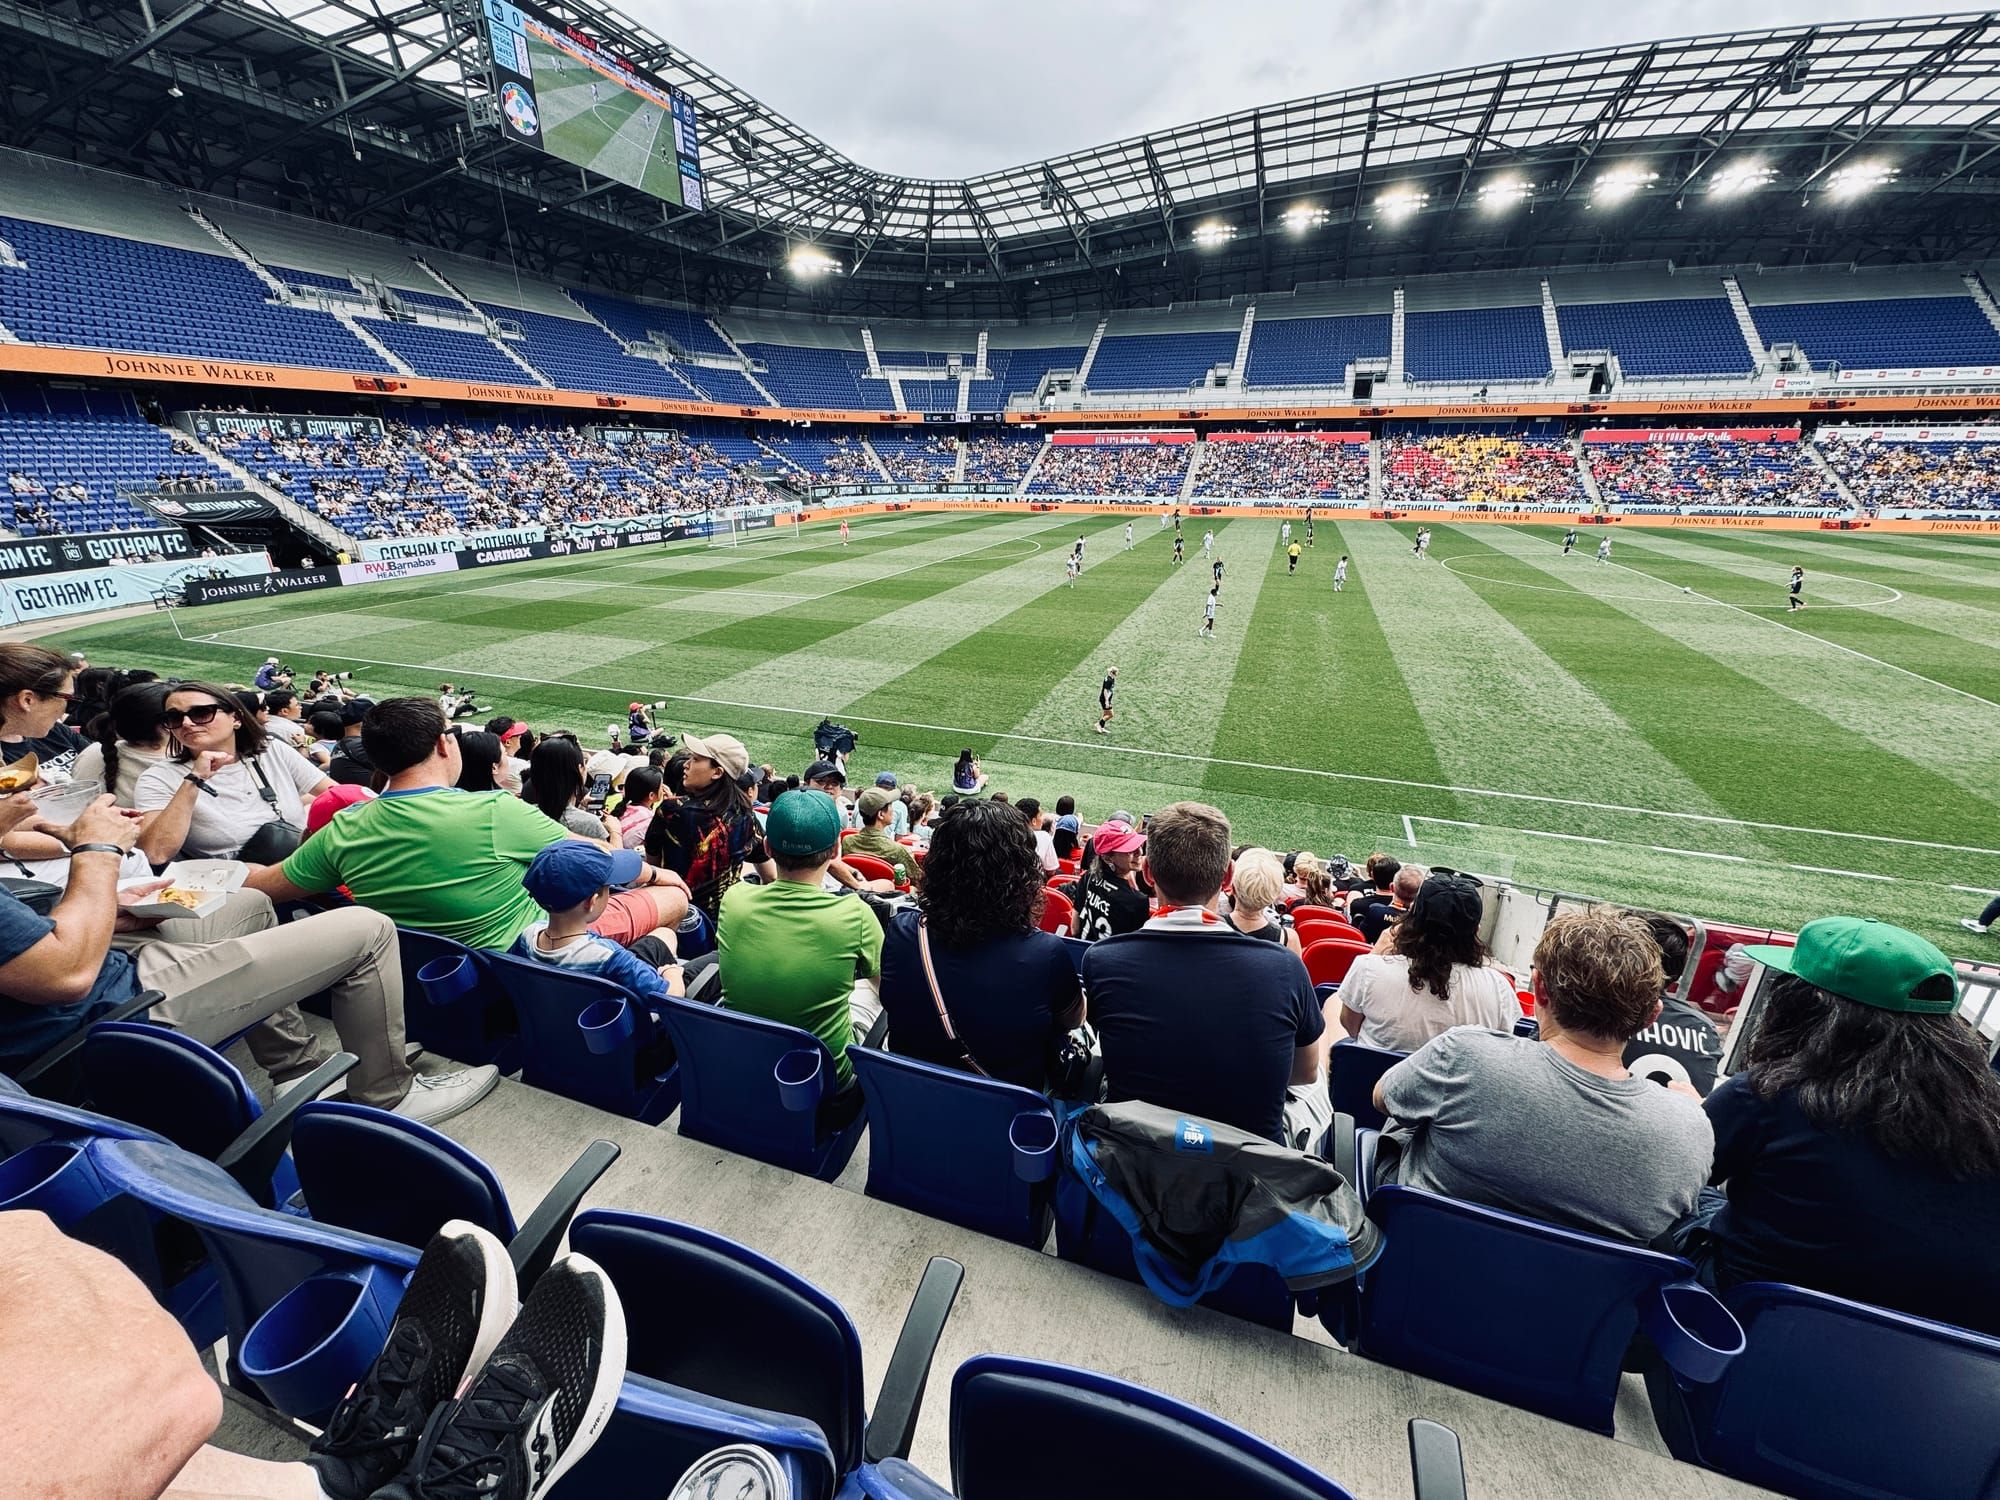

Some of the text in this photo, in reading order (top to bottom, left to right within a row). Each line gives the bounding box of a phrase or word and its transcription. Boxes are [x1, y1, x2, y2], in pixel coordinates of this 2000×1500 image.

[512, 11, 520, 27] 0
[674, 100, 679, 114] 0
[106, 357, 276, 382] JOHNNIE WALKER
[467, 386, 554, 401] JOHNNIE WALKER
[661, 402, 714, 412] JOHNNIE WALKER
[1656, 402, 1702, 412] JOHNNIE
[1914, 398, 1970, 408] JOHNNIE
[791, 411, 846, 420] JOHNNIE WALKER
[1247, 409, 1316, 418] JOHNNIE WALKER
[1437, 406, 1476, 415] JOHNNIE
[216, 417, 285, 438] GOTHAM FC
[307, 419, 350, 437] GOTHAM
[604, 430, 627, 443] GOTHAM
[1685, 432, 1705, 441] Red
[1705, 432, 1730, 441] Bulls
[184, 500, 262, 512] GOTHAM FC
[1672, 516, 1764, 526] JOHNNIE WALKER
[1928, 522, 1983, 531] JOHNNIE
[628, 531, 662, 544] NIKE SOCCER
[86, 535, 163, 560] GOTHAM
[163, 534, 187, 554] FC
[550, 534, 619, 555] ally ally ally
[28, 545, 53, 566] FC
[377, 569, 407, 579] HEALTH
[200, 574, 327, 600] JOHNNIE WALKER
[15, 578, 117, 610] GOTHAM FC
[1636, 1022, 1710, 1055] HOVIĆ
